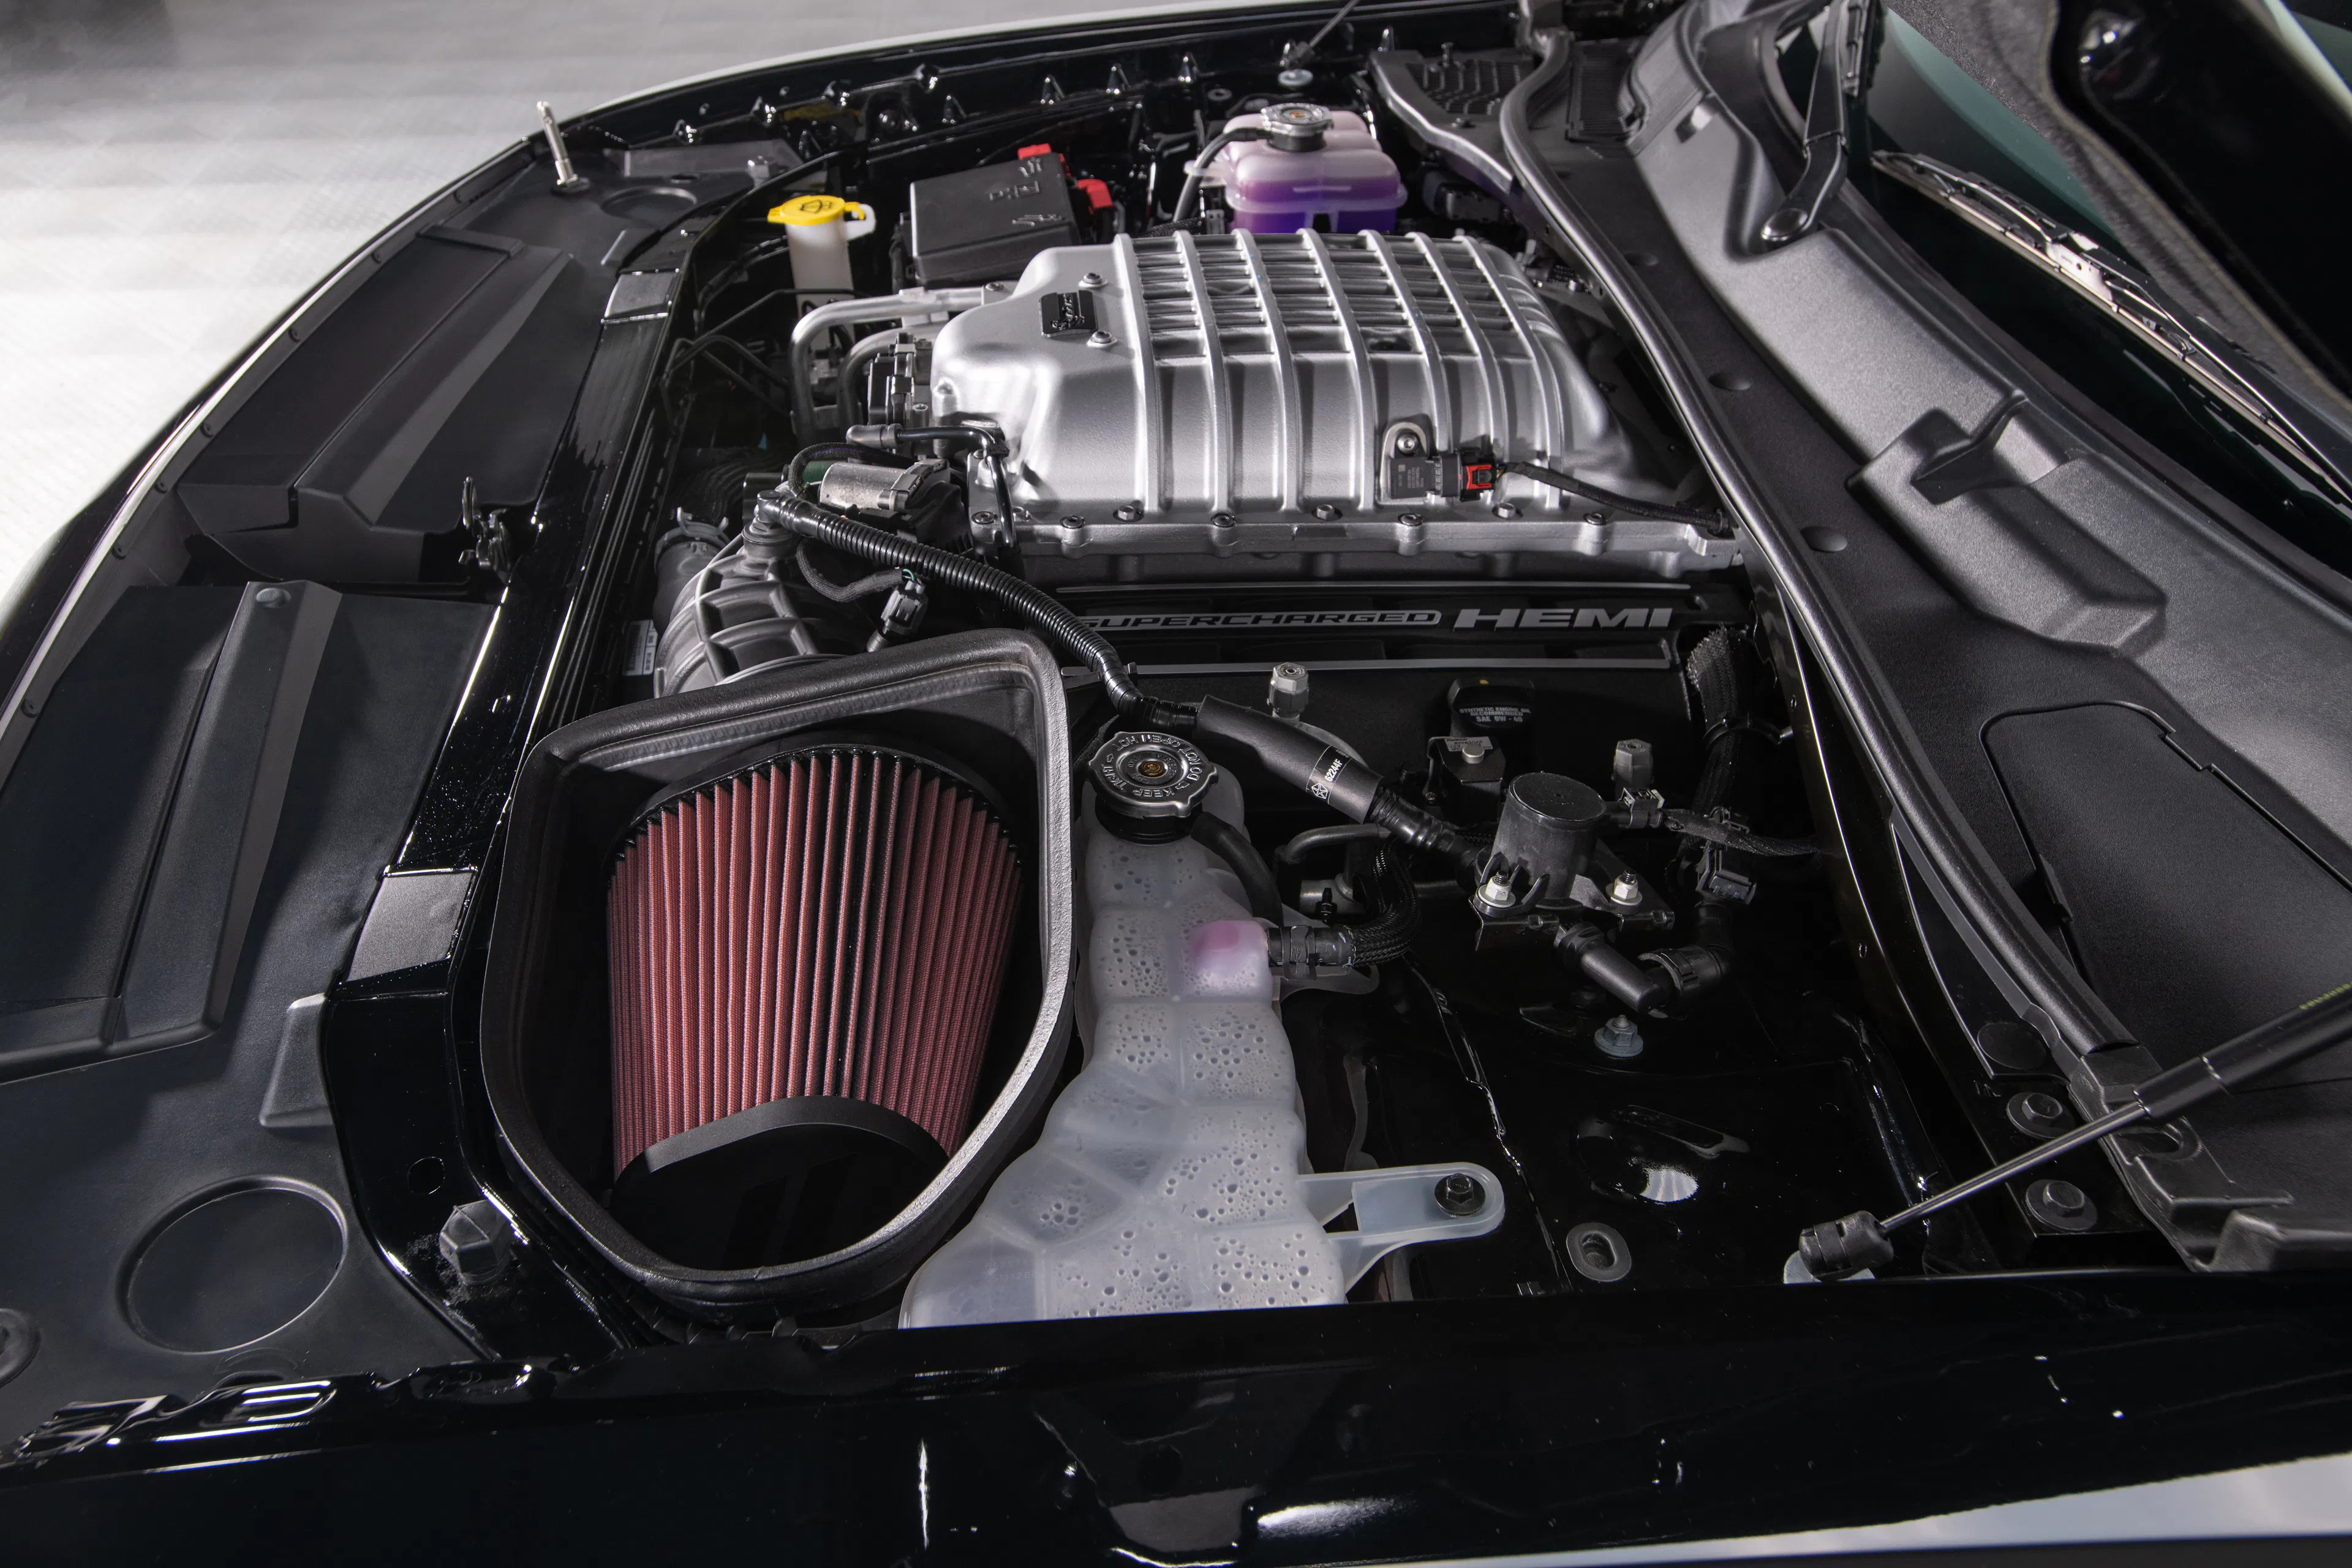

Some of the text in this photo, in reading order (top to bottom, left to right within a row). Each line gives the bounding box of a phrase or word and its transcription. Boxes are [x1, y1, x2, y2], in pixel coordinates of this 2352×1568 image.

[1080, 608, 1673, 628] SUPERCHARGED HEMI
[1112, 736, 1139, 752] HOT
[1141, 734, 1182, 748] OPEN
[1179, 747, 1200, 766] NOT
[1101, 763, 1128, 790] TIGHT
[1186, 767, 1203, 781] DO
[1324, 758, 1343, 782] 62244F
[1132, 788, 1175, 798] KEEP
